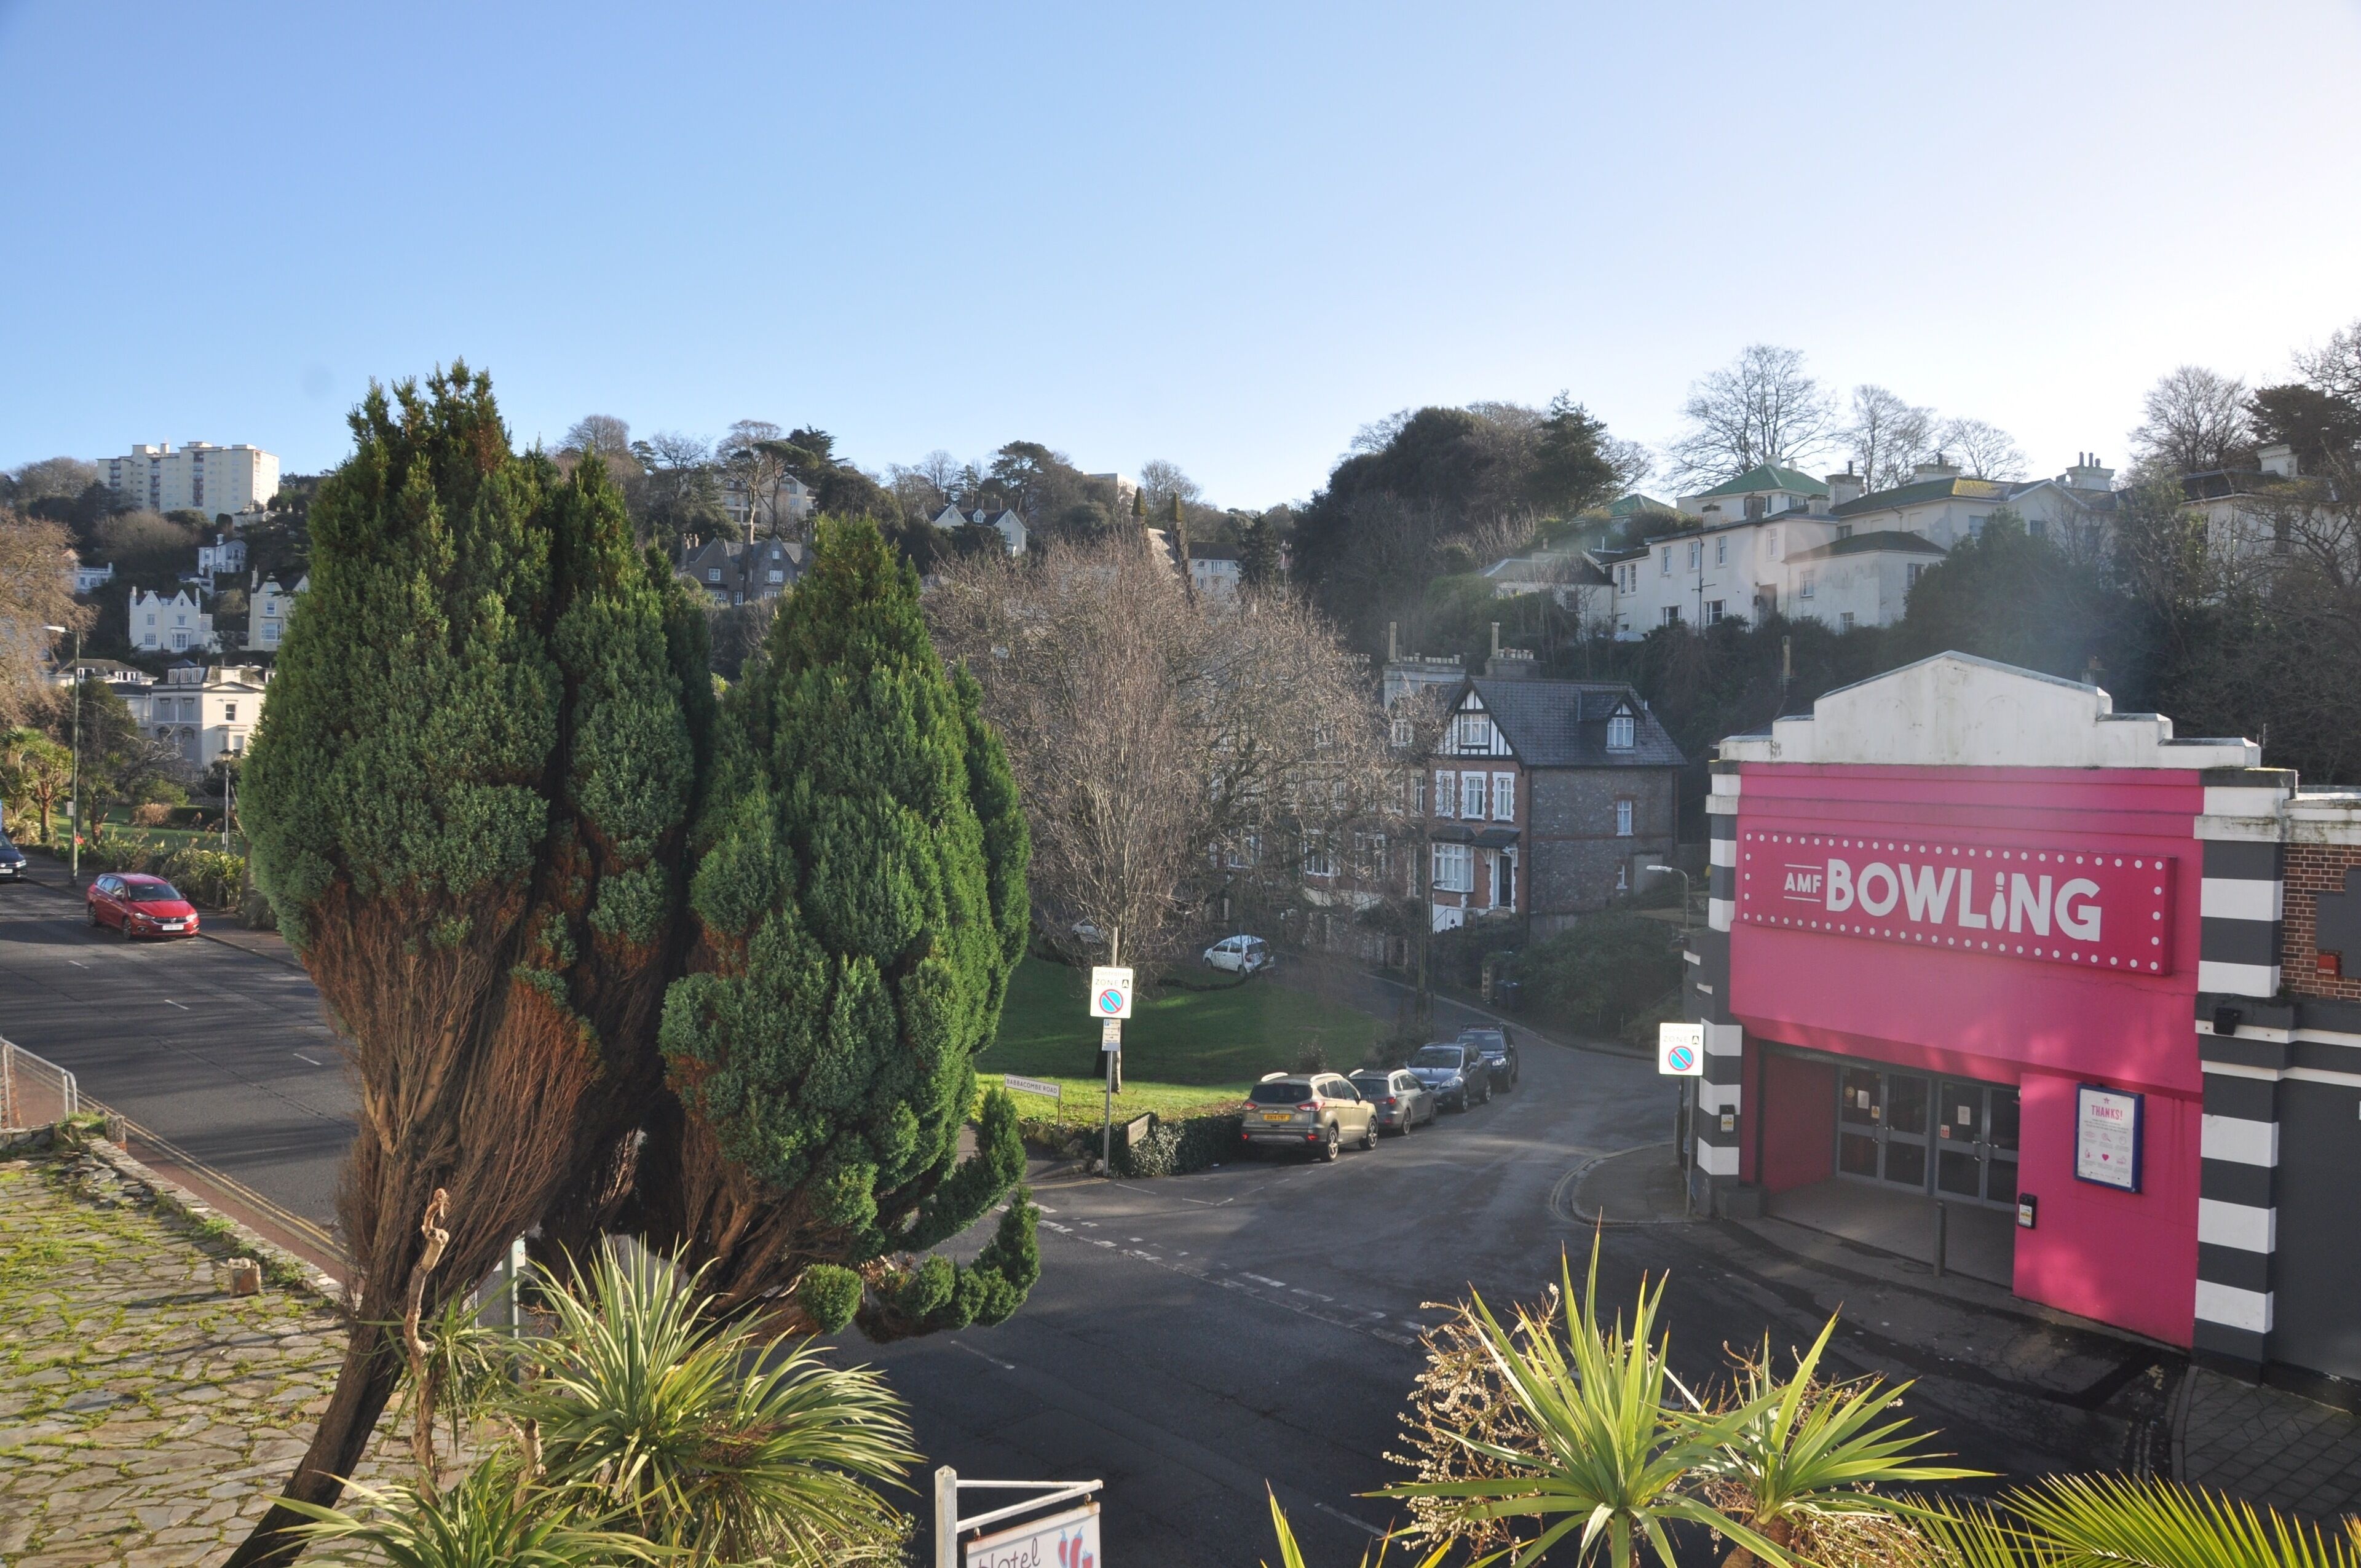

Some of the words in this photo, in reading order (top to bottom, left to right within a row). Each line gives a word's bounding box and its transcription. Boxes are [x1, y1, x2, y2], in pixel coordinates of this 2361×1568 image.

[1784, 874, 1822, 894] AMF
[1122, 979, 1129, 988] A
[1692, 1035, 1699, 1045] A
[1006, 1078, 1042, 1091] BABBACOMBE
[1043, 1085, 1058, 1094] ROAD
[2091, 1105, 2123, 1121] THANKS!
